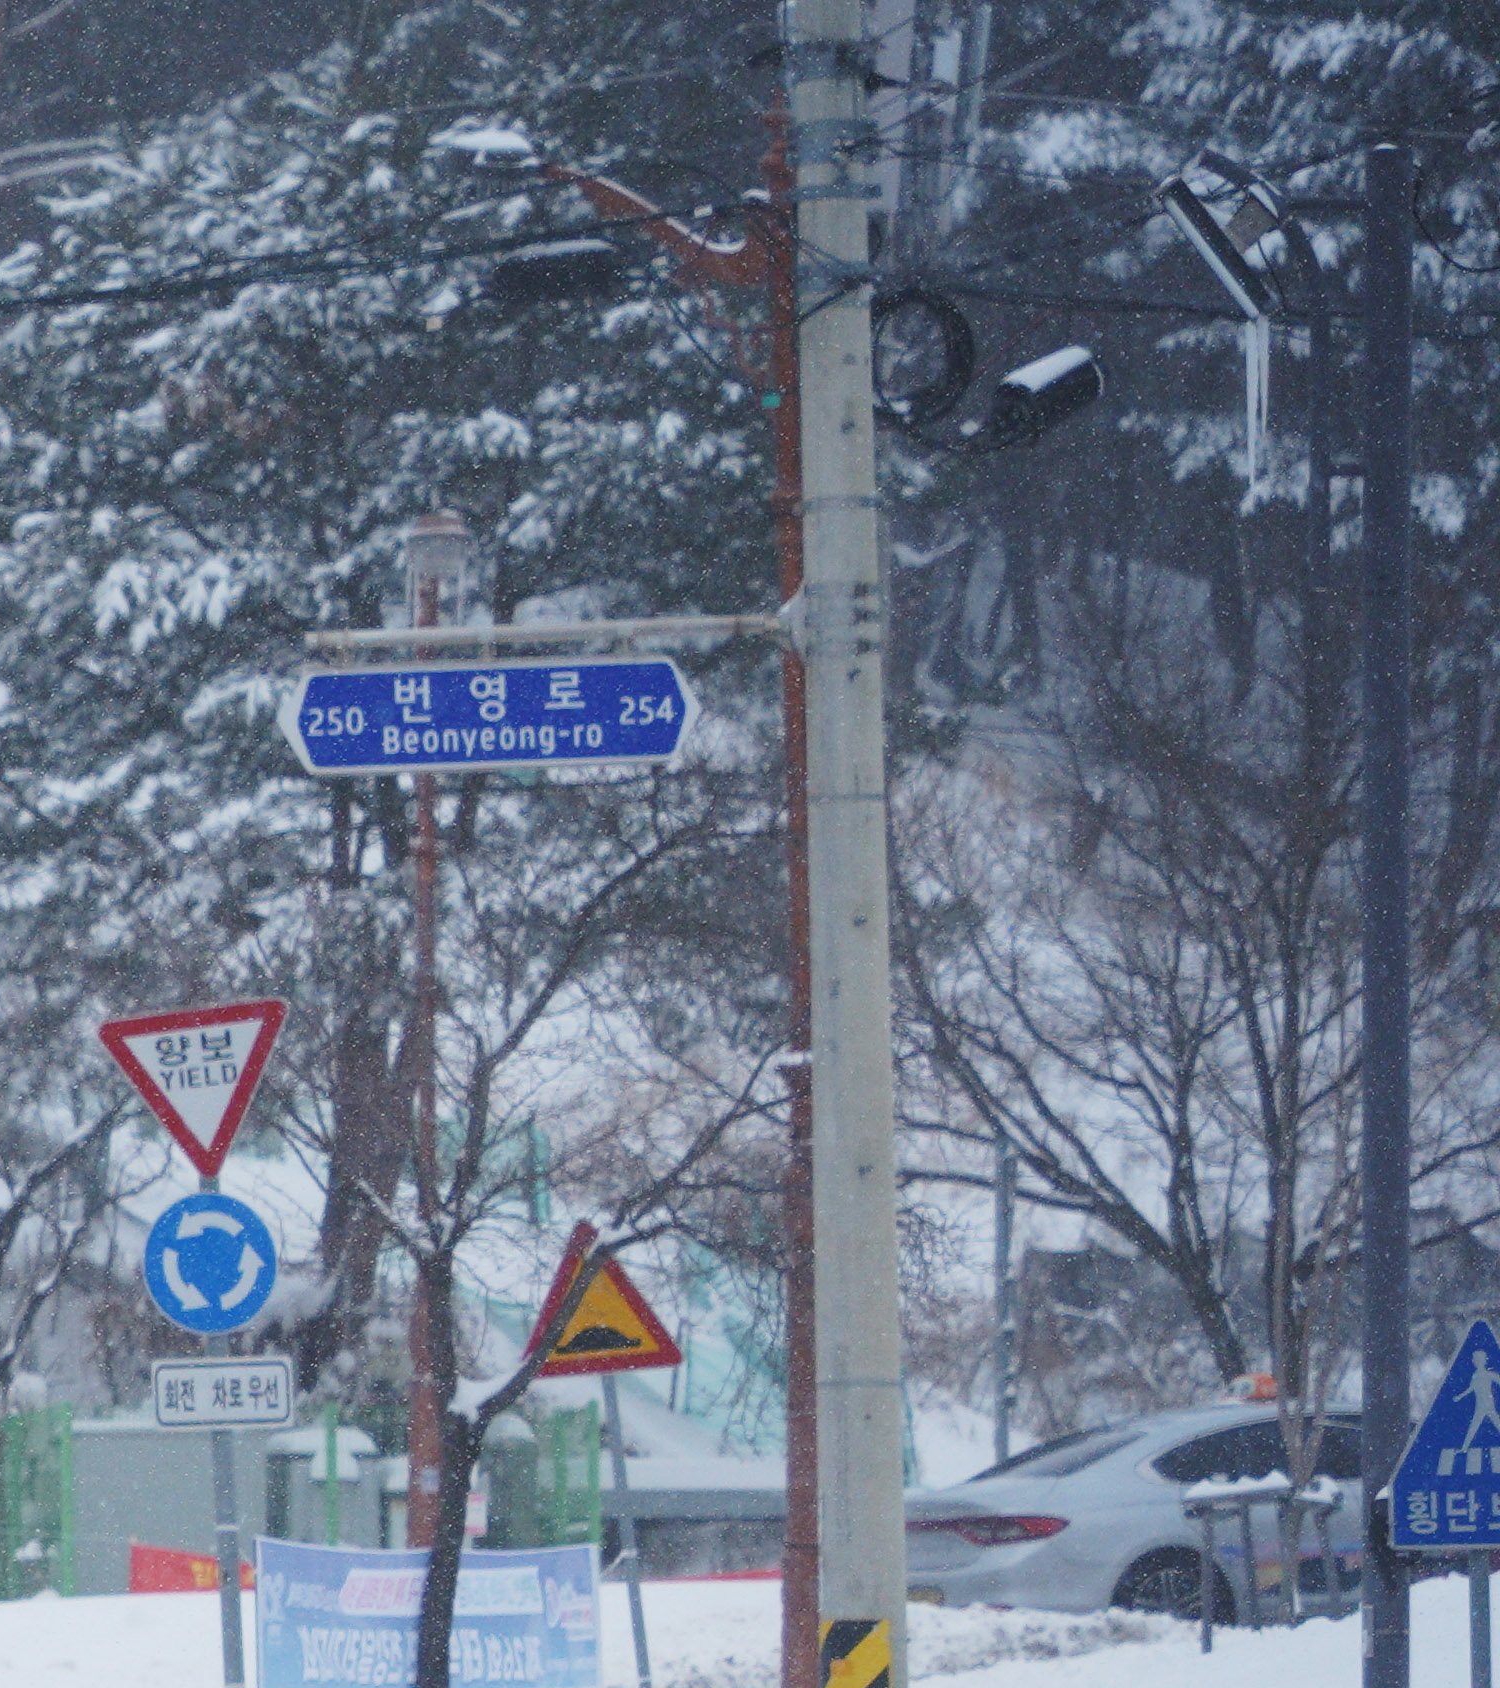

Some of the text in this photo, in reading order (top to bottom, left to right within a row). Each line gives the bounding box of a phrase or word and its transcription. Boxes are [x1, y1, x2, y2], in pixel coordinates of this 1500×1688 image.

[394, 671, 586, 723] 번영로
[618, 696, 675, 725] 254
[307, 706, 365, 737] 250
[383, 722, 604, 757] Beonyeong-ro
[155, 1029, 234, 1067] 양보
[160, 1062, 237, 1091] YIELD
